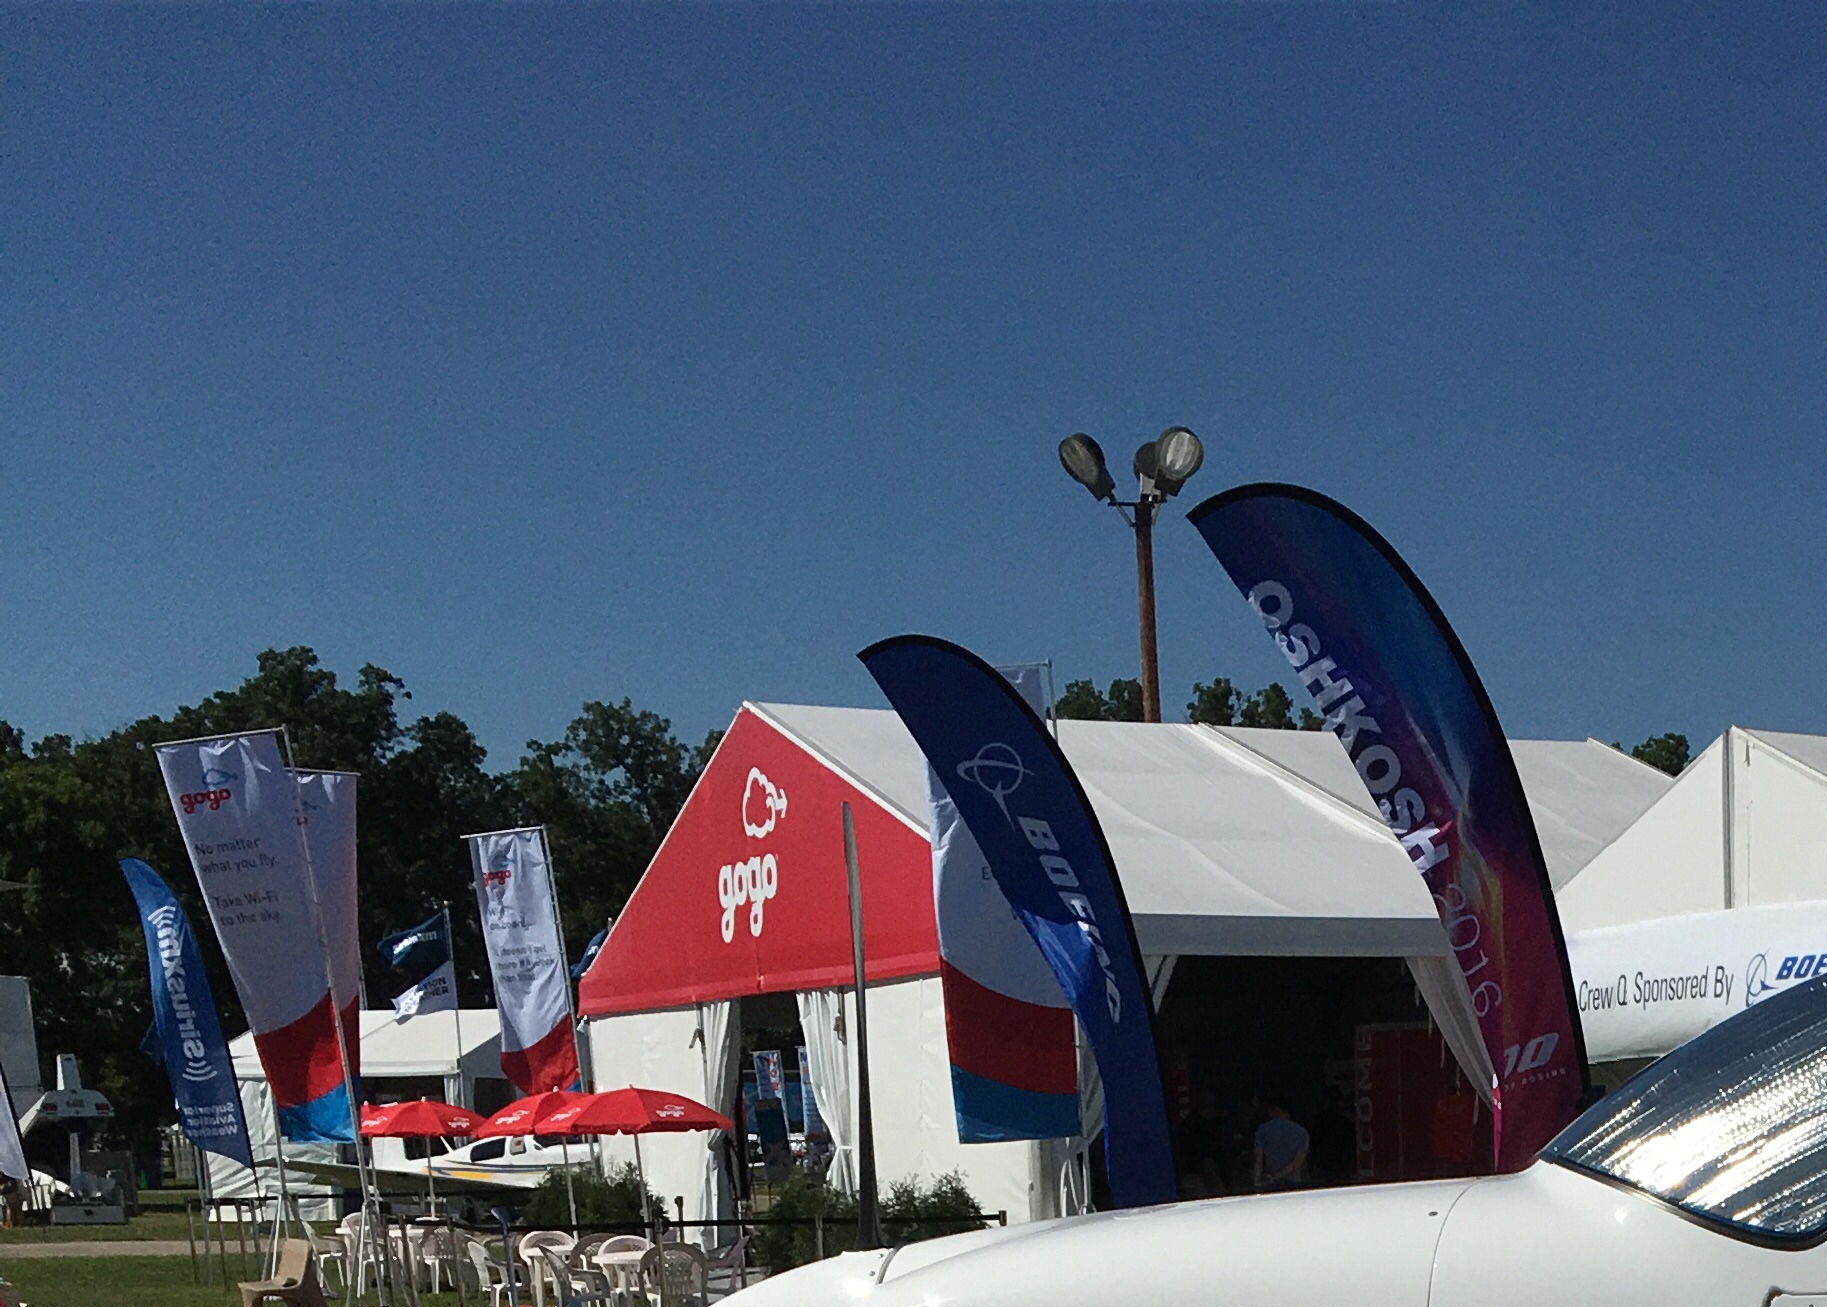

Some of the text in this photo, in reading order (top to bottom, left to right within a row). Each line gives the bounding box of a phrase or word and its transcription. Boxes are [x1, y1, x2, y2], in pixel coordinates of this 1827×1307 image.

[1248, 580, 1450, 876] OSHKOSH
[180, 788, 232, 814] gogo
[194, 838, 260, 855] No matter
[202, 860, 232, 873] what
[234, 858, 257, 874] you
[482, 869, 511, 887] gogo
[211, 889, 280, 909] Take Wi-Fi
[718, 853, 778, 944] gogo
[220, 915, 235, 926] to
[236, 911, 257, 924] the
[1435, 882, 1502, 1018] 2016
[1579, 980, 1613, 1012] Crew
[1633, 966, 1709, 1011] Sponsored
[1713, 965, 1735, 1006] By
[1357, 1029, 1375, 1179] LCOME
